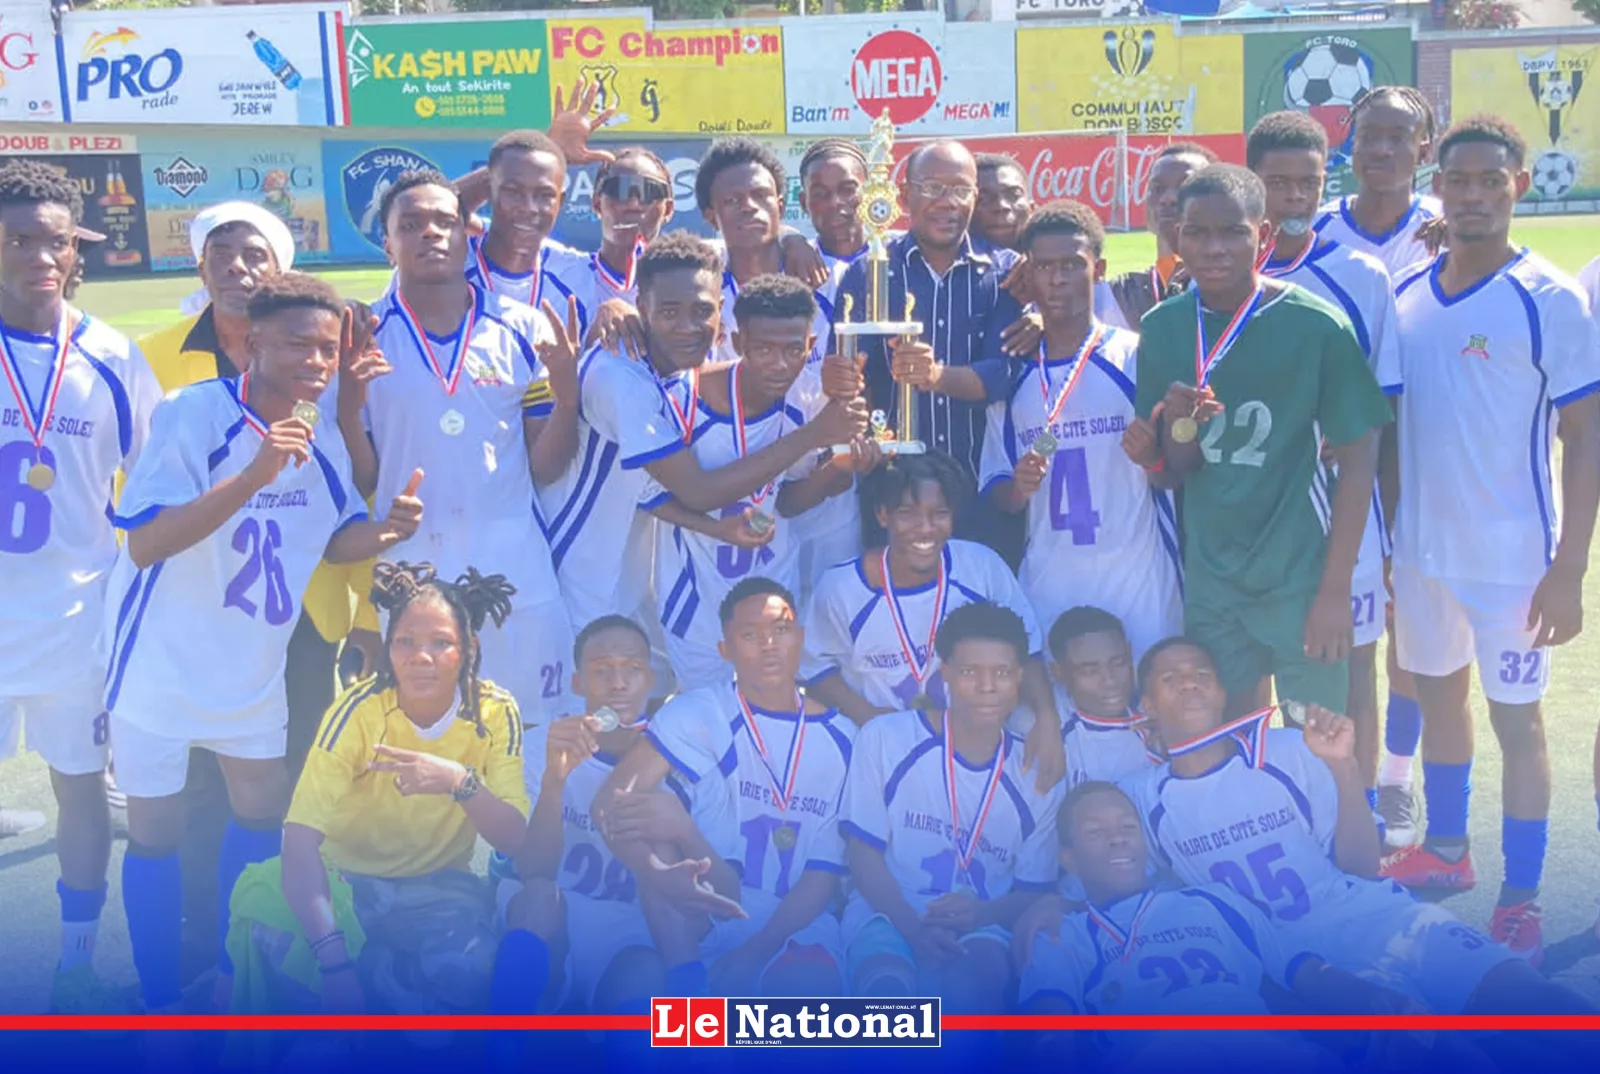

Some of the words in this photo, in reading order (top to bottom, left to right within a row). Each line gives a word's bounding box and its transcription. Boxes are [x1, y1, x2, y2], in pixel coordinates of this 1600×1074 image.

[551, 27, 605, 59] FC
[1326, 35, 1358, 48] TORO
[76, 48, 183, 102] PRO
[372, 48, 467, 80] KA$H
[472, 48, 542, 75] PAW
[855, 56, 937, 99] MEGA
[142, 91, 179, 110] rade
[402, 82, 420, 94] An
[425, 81, 452, 93] tout
[792, 105, 849, 123] Ban'm
[943, 102, 1010, 120] MEGA'M!
[69, 137, 122, 151] PLEZI
[153, 167, 208, 185] Diamond
[236, 166, 313, 191] DG
[347, 161, 374, 180] FC
[1026, 148, 1167, 207] Coca-Col
[1200, 401, 1273, 468] 22
[1050, 447, 1100, 546] 4
[223, 516, 294, 626] 26
[1500, 650, 1541, 685] 32
[1211, 828, 1231, 850] DE
[740, 814, 802, 900] 17
